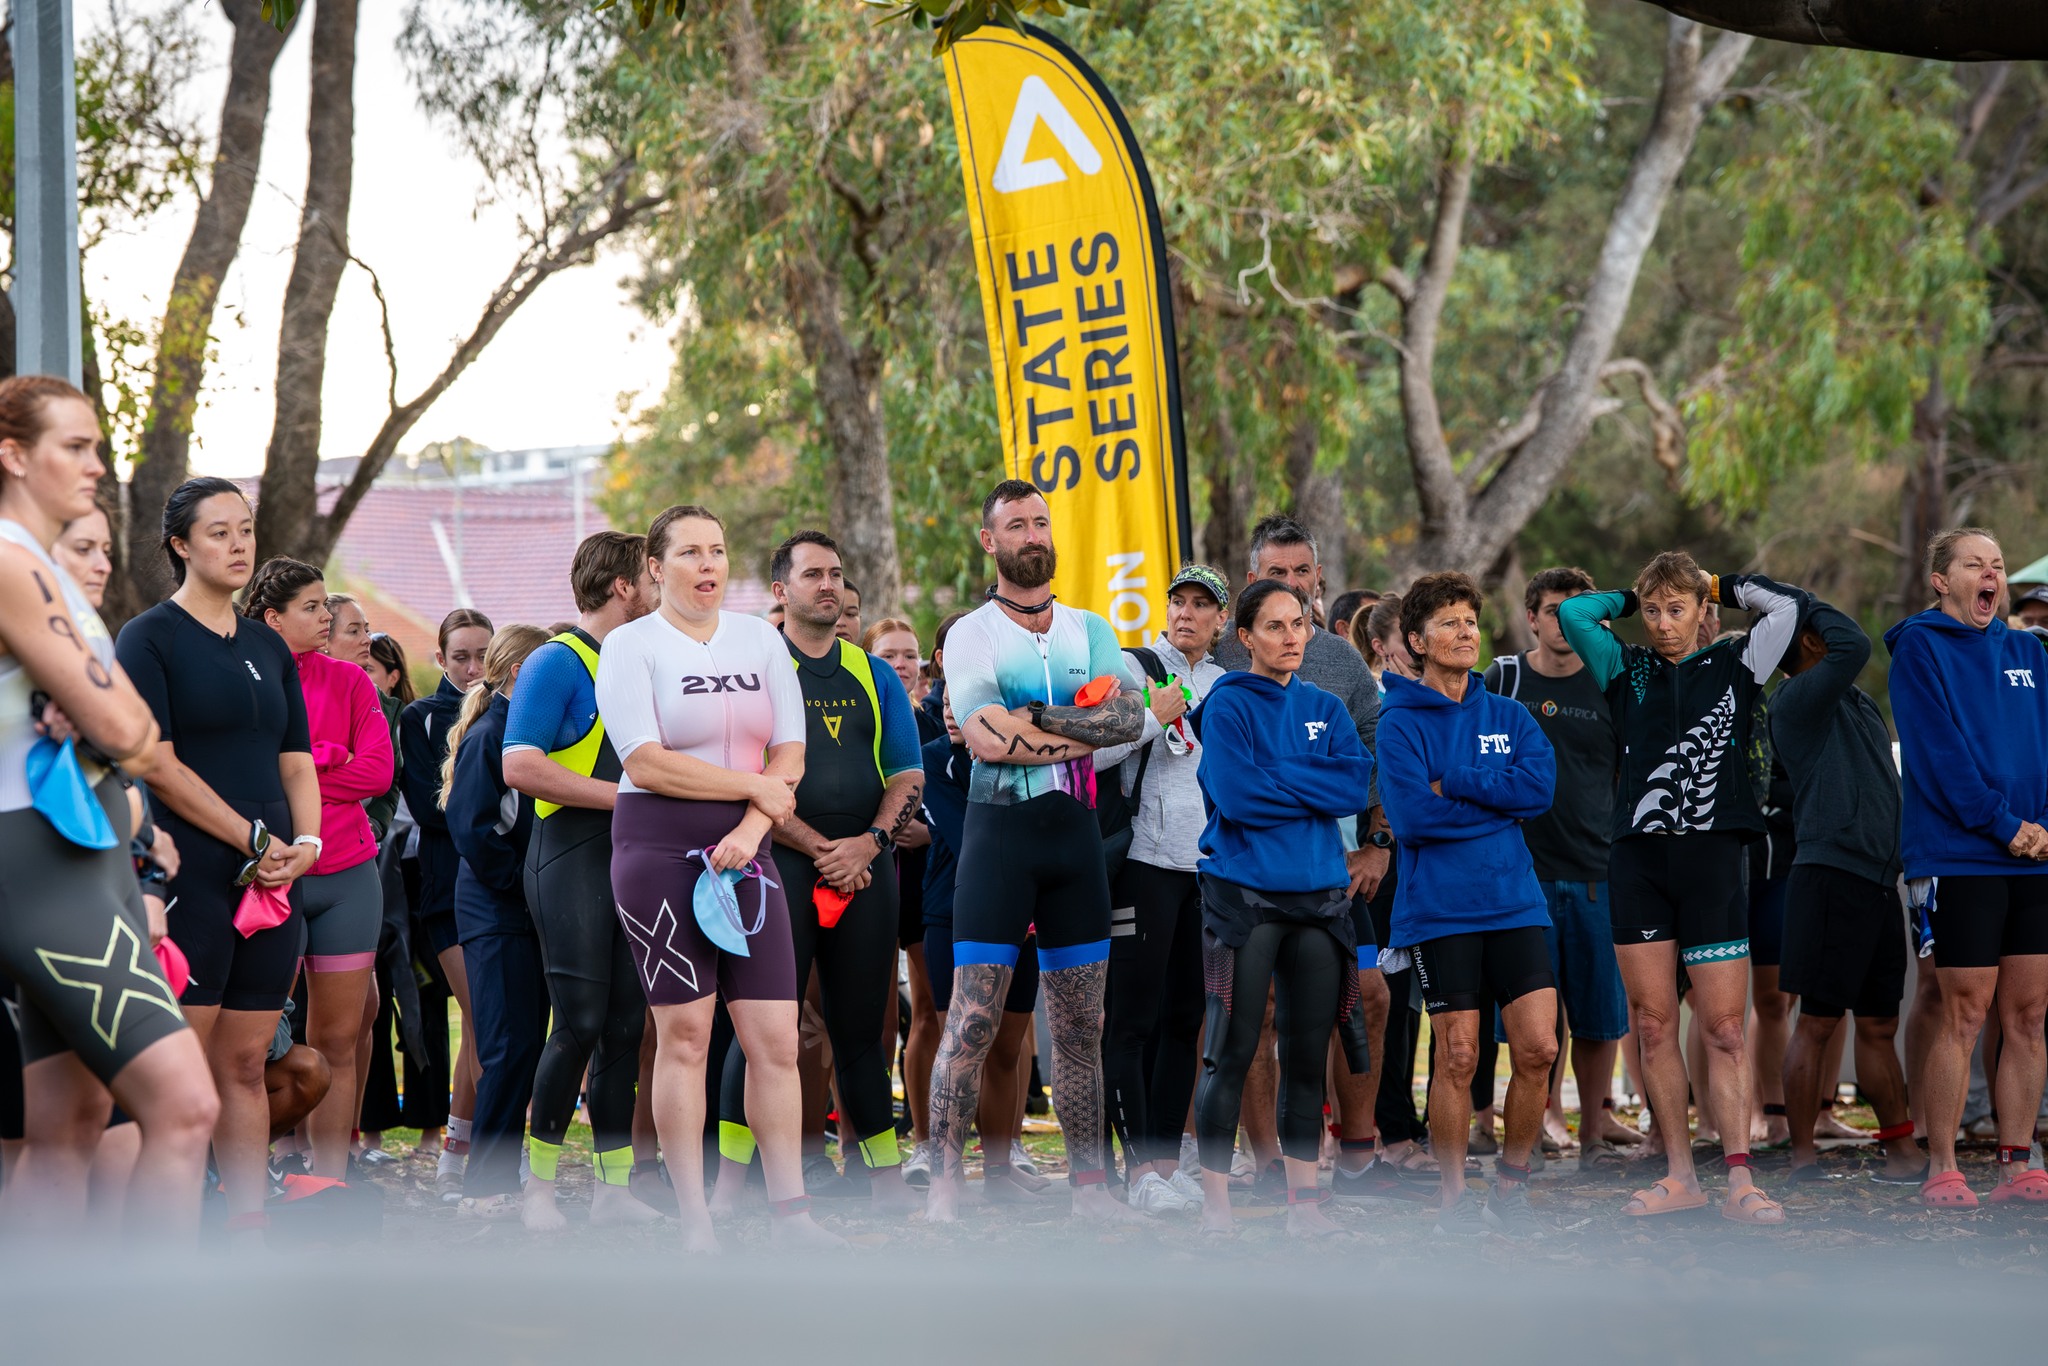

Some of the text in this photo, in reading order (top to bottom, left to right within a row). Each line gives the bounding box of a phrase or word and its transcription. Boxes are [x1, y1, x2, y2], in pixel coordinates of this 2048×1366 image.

[1070, 231, 1141, 482] SERIES
[1005, 243, 1082, 494] STATE
[1106, 551, 1152, 648] ON
[681, 673, 761, 695] 2XU
[2004, 669, 2035, 688] FTC
[806, 699, 857, 708] VOLARE
[1520, 701, 1598, 720] TH AFRICA
[1478, 734, 1511, 754] FTC
